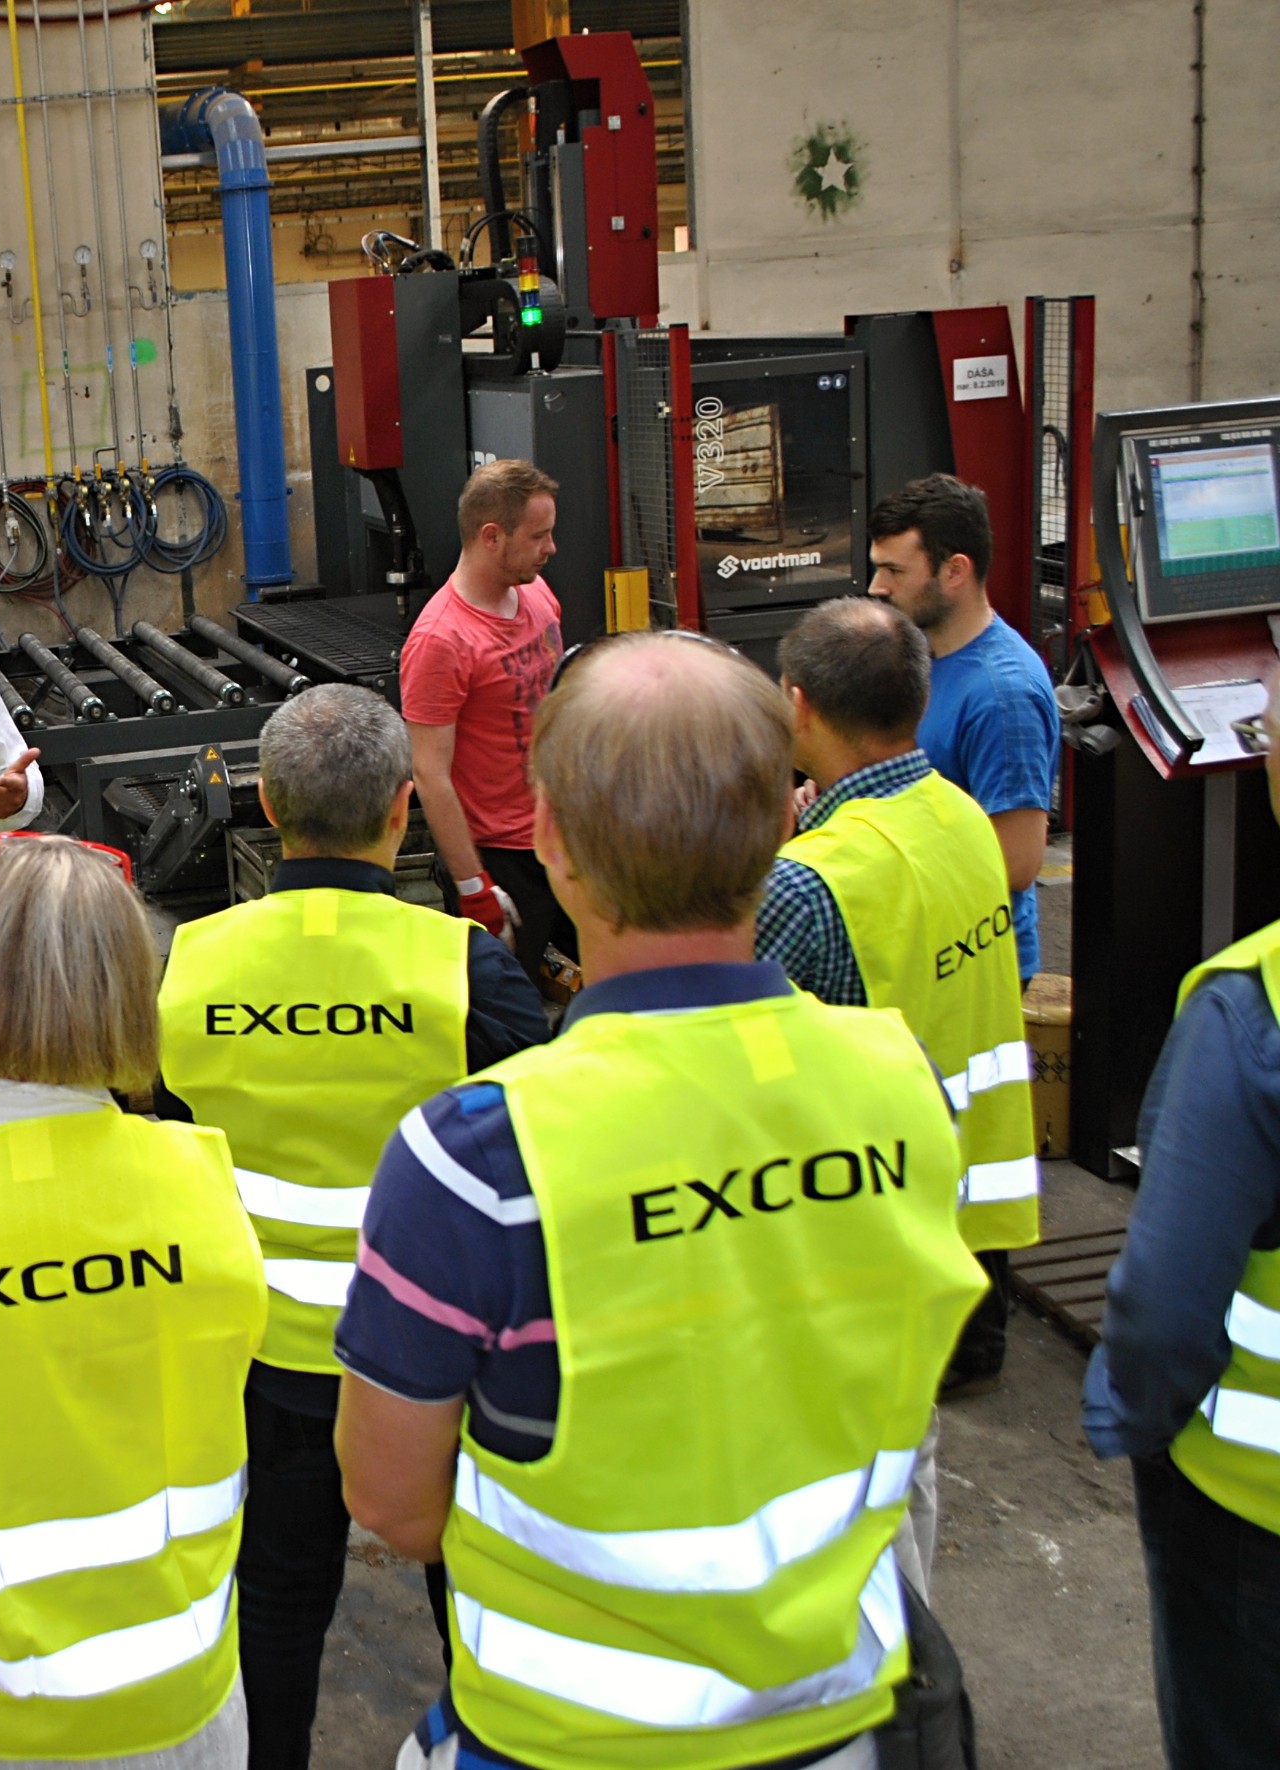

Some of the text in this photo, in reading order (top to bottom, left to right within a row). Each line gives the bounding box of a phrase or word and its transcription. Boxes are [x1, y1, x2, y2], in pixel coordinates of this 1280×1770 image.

[695, 396, 725, 494] V320
[740, 551, 821, 572] voortman
[936, 904, 1011, 981] EXCO
[206, 1002, 415, 1036] EXCON
[630, 1139, 906, 1243] EXCON
